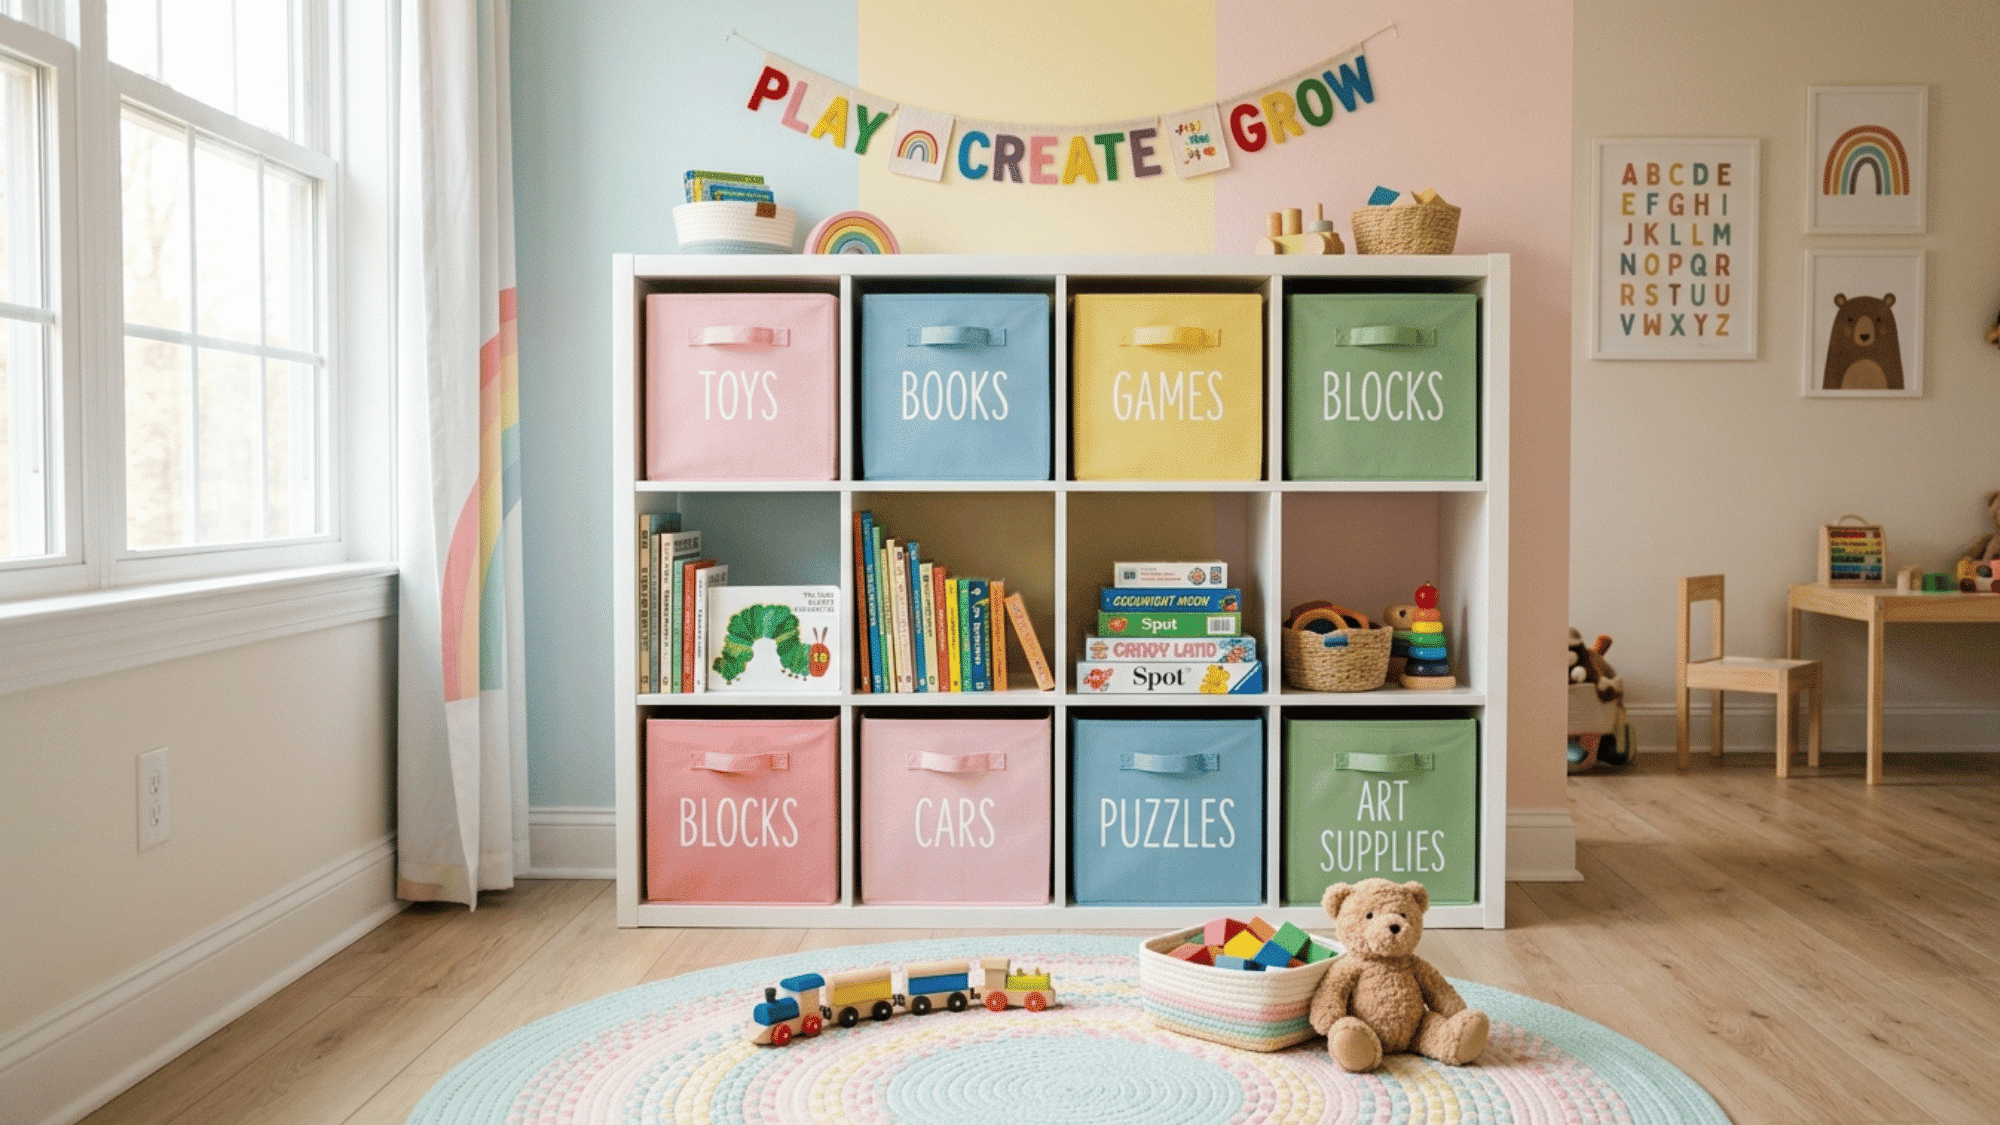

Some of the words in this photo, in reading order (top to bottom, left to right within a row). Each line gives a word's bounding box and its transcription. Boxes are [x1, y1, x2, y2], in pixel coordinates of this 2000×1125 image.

[747, 65, 889, 156] PLAY
[958, 128, 1163, 185] CREATE
[1230, 55, 1374, 152] GROW
[1621, 163, 1638, 186] A
[1646, 163, 1661, 185] B
[1669, 163, 1684, 186] C
[1693, 163, 1709, 185] D
[1717, 163, 1731, 186] E
[1622, 192, 1635, 216] E
[1646, 192, 1659, 215] F
[1669, 193, 1684, 216] G
[1694, 193, 1709, 216] H
[1722, 193, 1727, 216] I
[1623, 222, 1633, 246] J
[1644, 223, 1659, 245] K
[1670, 223, 1682, 246] L
[1692, 223, 1704, 246] L
[1713, 223, 1731, 245] M
[1620, 253, 1636, 275] N
[1645, 253, 1660, 276] O
[1669, 253, 1683, 275] P
[1690, 253, 1707, 276] Q
[1715, 254, 1730, 276] R
[1620, 283, 1635, 305] R
[1645, 283, 1658, 306] S
[1668, 283, 1681, 306] T
[1691, 284, 1705, 306] U
[1715, 284, 1730, 306] U
[1620, 313, 1635, 336] V
[1644, 313, 1661, 336] W
[1670, 314, 1685, 336] X
[1694, 314, 1708, 336] Y
[1716, 313, 1730, 336] Z
[699, 371, 778, 420] TOYS
[902, 371, 1008, 421] BOOKS
[1113, 371, 1223, 421] GAMES
[1322, 371, 1443, 421] BLOCKS
[1133, 666, 1185, 691] Spot
[1357, 780, 1408, 822] ART
[680, 797, 798, 848] BLOCKS
[915, 797, 995, 848] CARS
[1100, 798, 1235, 849] PUZZLES
[1320, 830, 1445, 872] SUPPLIES
